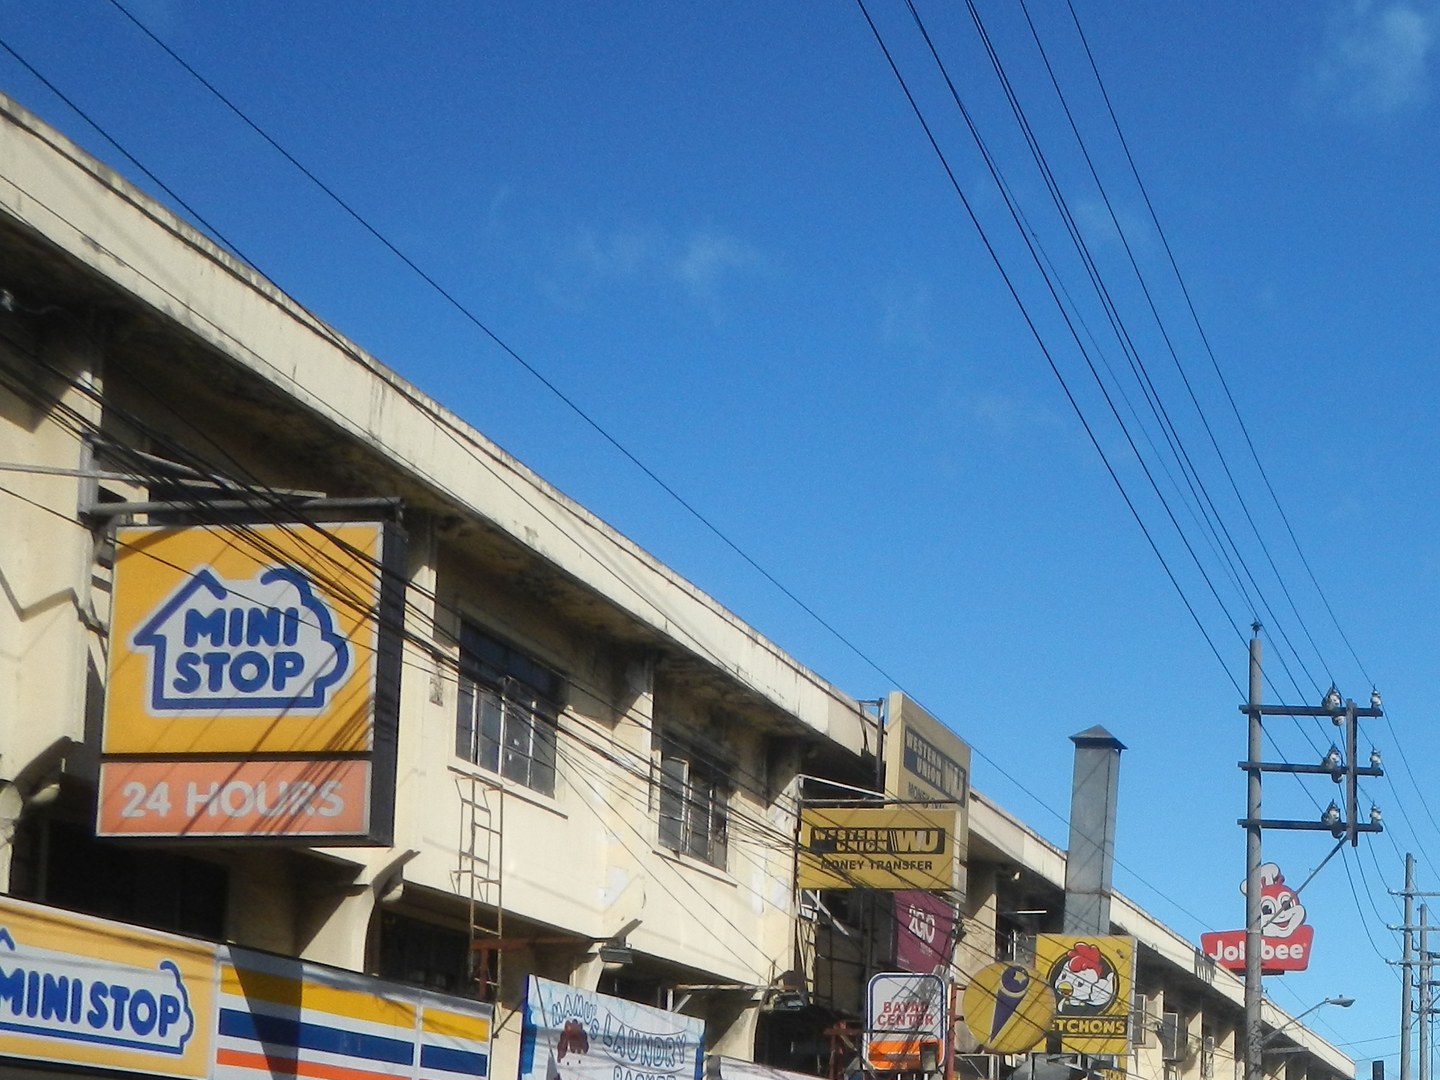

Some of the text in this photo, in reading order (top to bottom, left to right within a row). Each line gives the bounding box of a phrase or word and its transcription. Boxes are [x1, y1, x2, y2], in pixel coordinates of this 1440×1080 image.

[184, 606, 299, 648] MINI
[172, 650, 305, 694] STOP
[905, 727, 942, 773] WESTERN
[916, 759, 943, 789] UNION
[121, 779, 345, 818] 24 HOURS
[812, 829, 888, 841] WESTERN
[835, 829, 939, 852] UNION WU
[821, 860, 933, 871] MONEY TRANSFER
[908, 904, 936, 944] 2GO
[1209, 939, 1304, 961] Jolbee
[0, 965, 181, 1038] MINI STOP
[883, 1001, 929, 1014] BAYAD
[877, 1013, 934, 1026] CENTER
[603, 1013, 687, 1069] LAUNDRY
